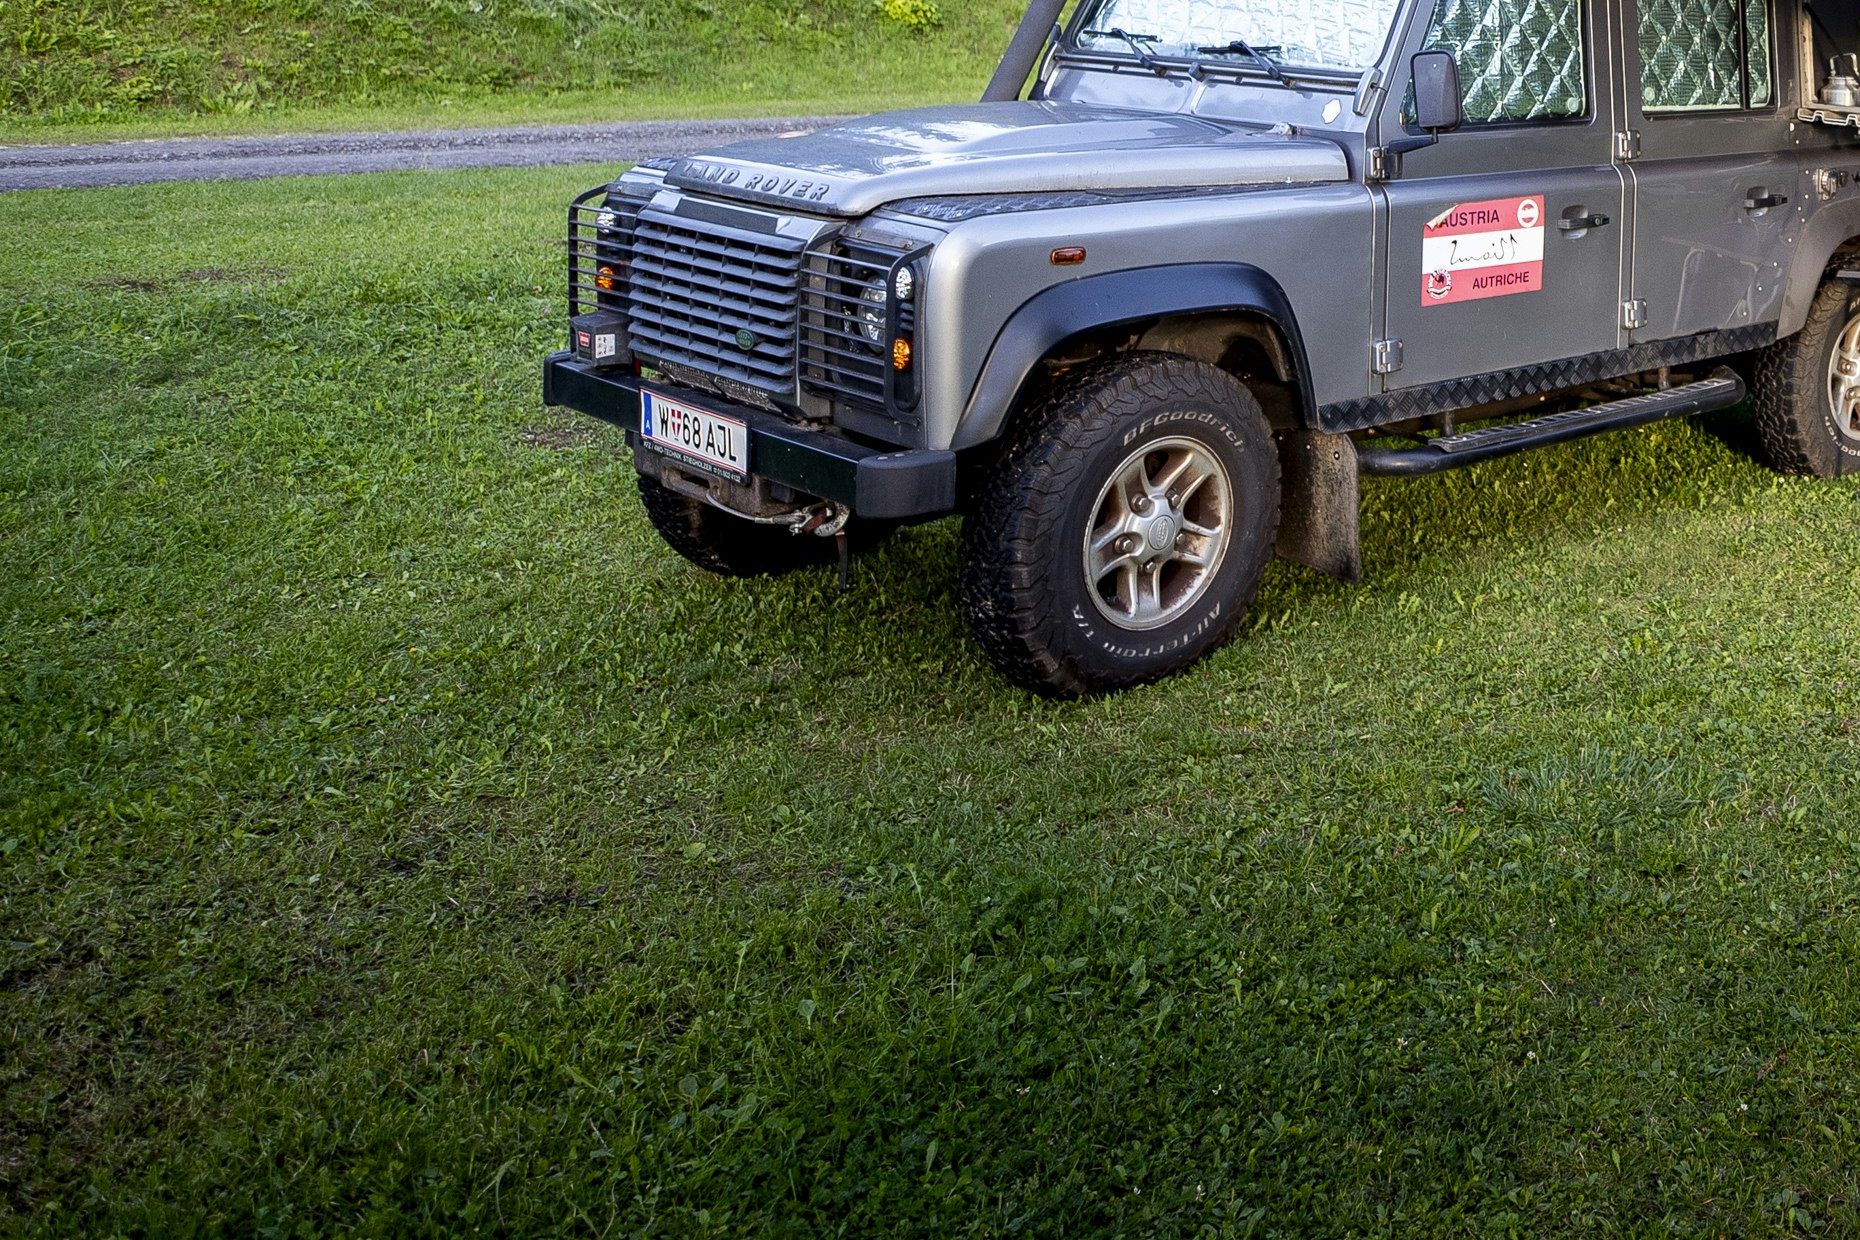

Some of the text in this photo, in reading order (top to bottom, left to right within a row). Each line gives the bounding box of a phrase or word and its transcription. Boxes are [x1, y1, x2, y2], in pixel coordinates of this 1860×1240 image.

[681, 162, 830, 201] LAND ROVER
[1441, 209, 1500, 228] AUSTRIA
[1472, 272, 1530, 290] AUTRICHE
[645, 420, 651, 429] A
[658, 404, 737, 462] W 68 AJL
[1124, 411, 1246, 454] BFGoodrich
[1072, 600, 1222, 658] All-Terrain T/A
